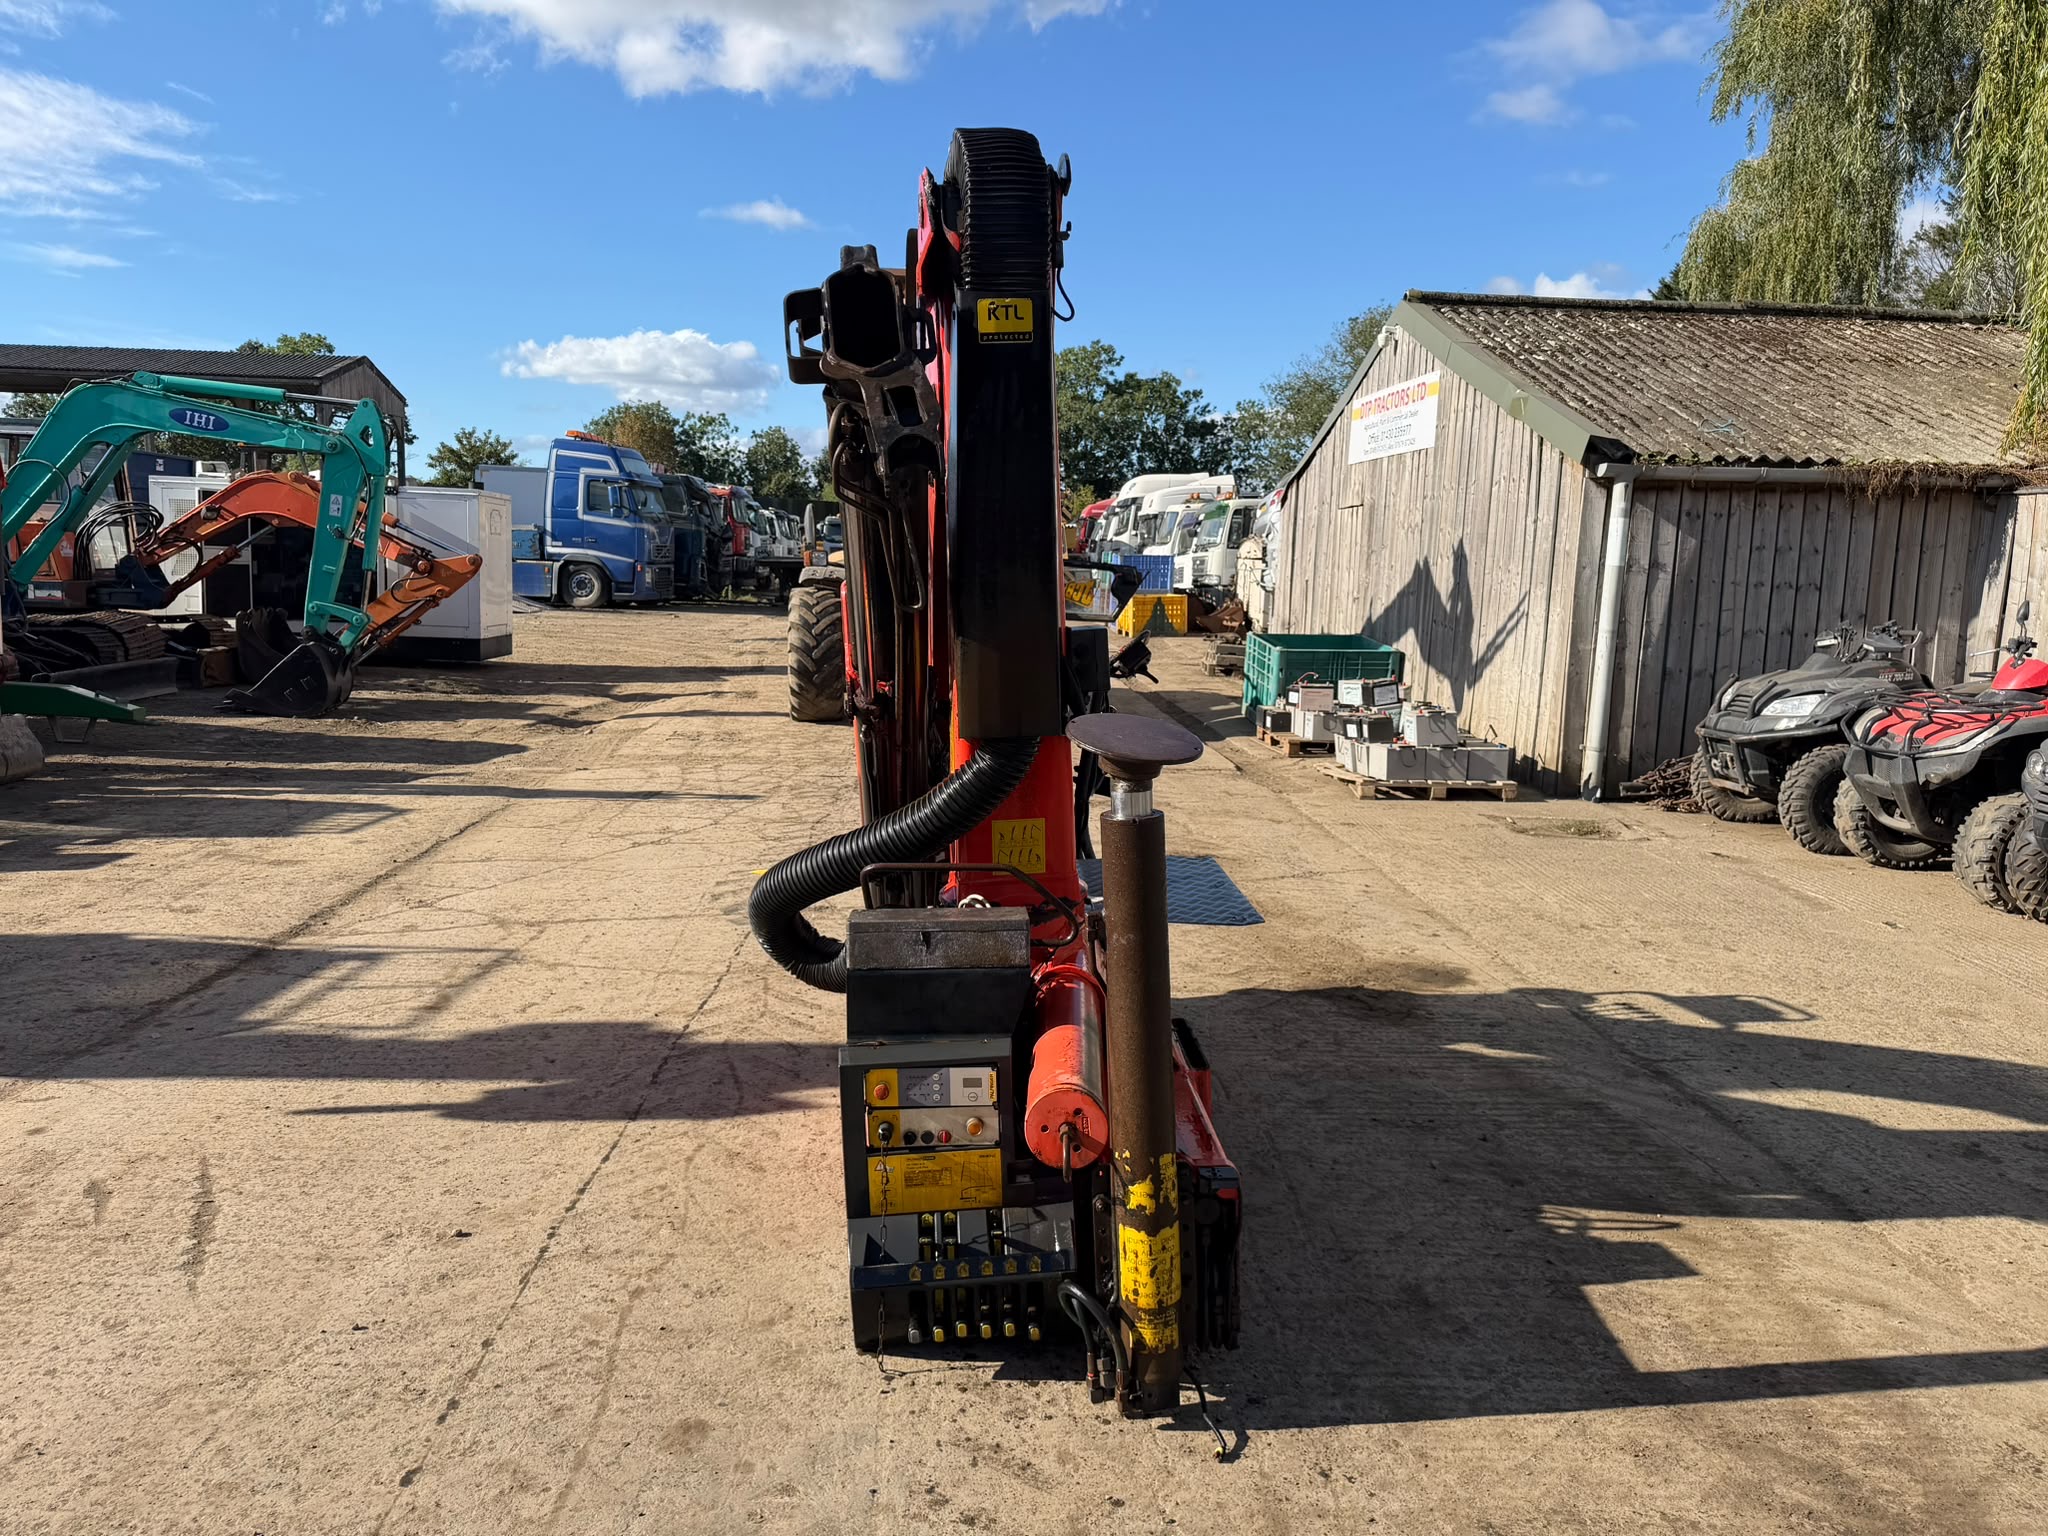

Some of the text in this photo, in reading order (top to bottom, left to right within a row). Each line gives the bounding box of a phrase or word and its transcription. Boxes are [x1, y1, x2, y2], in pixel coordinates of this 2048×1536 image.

[983, 332, 1031, 342] protected
[1373, 387, 1411, 416] TRACTORS
[1412, 382, 1427, 403] LTD
[184, 410, 217, 431] IHI
